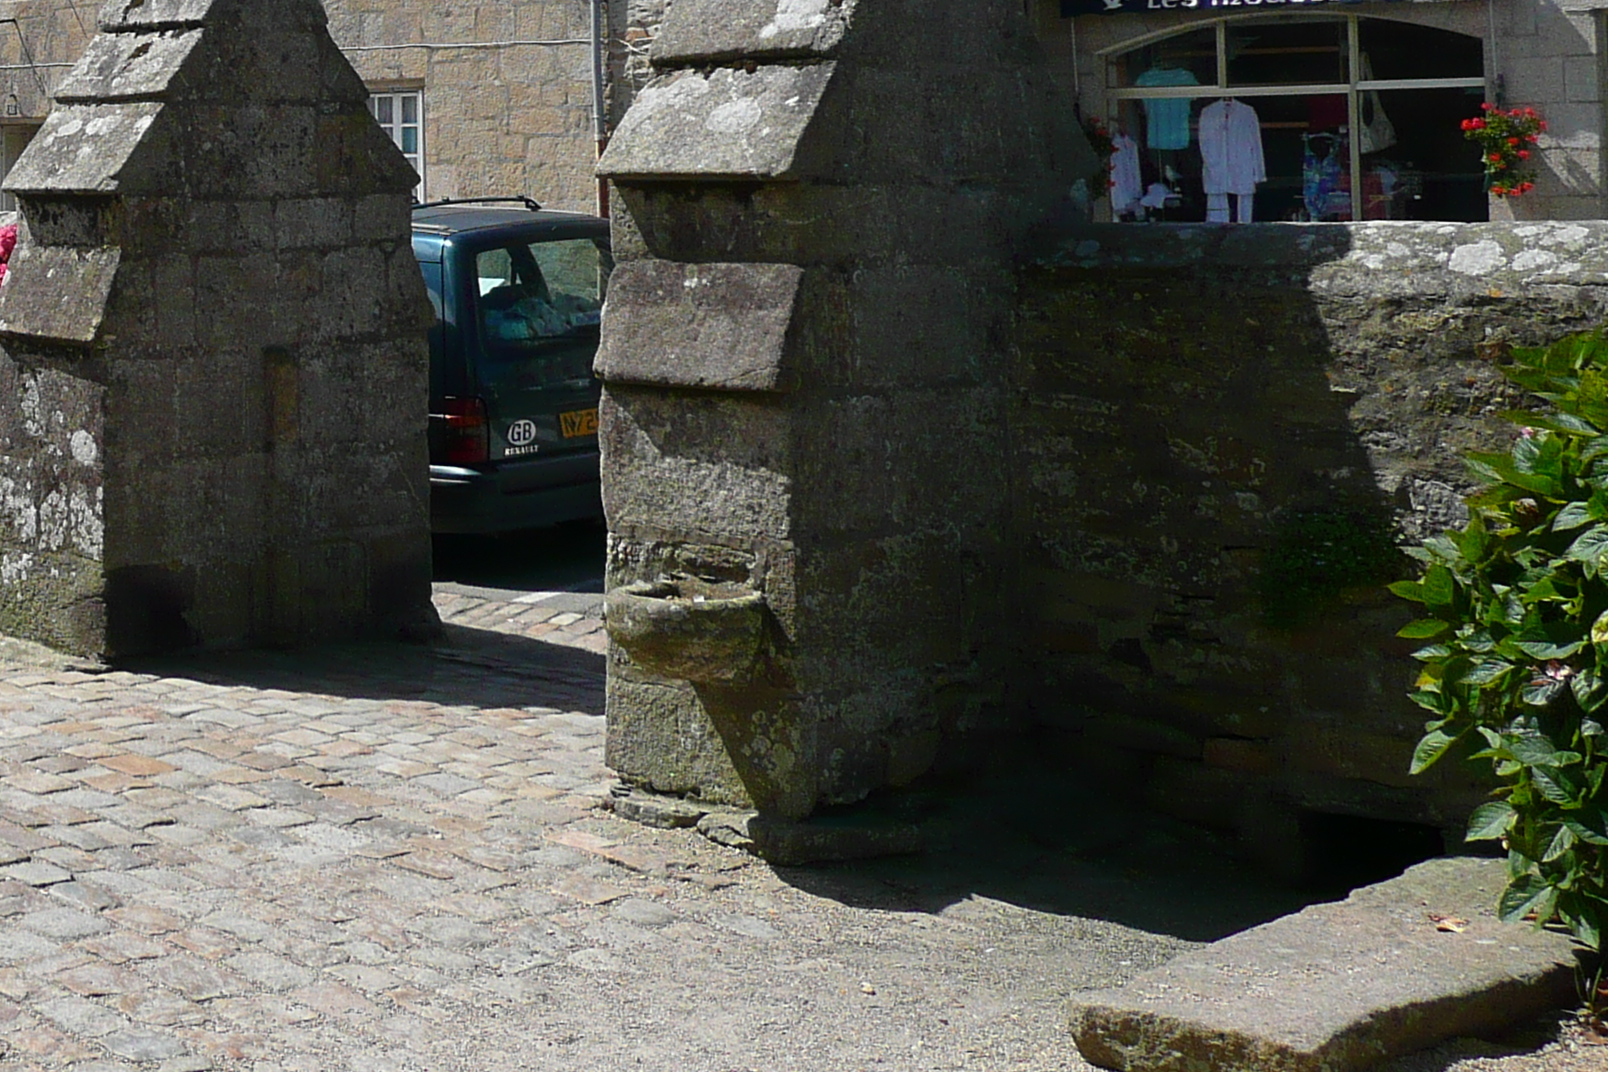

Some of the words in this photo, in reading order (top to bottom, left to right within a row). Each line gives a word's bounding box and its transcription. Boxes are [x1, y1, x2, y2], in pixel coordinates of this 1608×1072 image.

[511, 422, 533, 442] GB
[563, 412, 599, 435] N72
[504, 445, 539, 456] RENAULT
